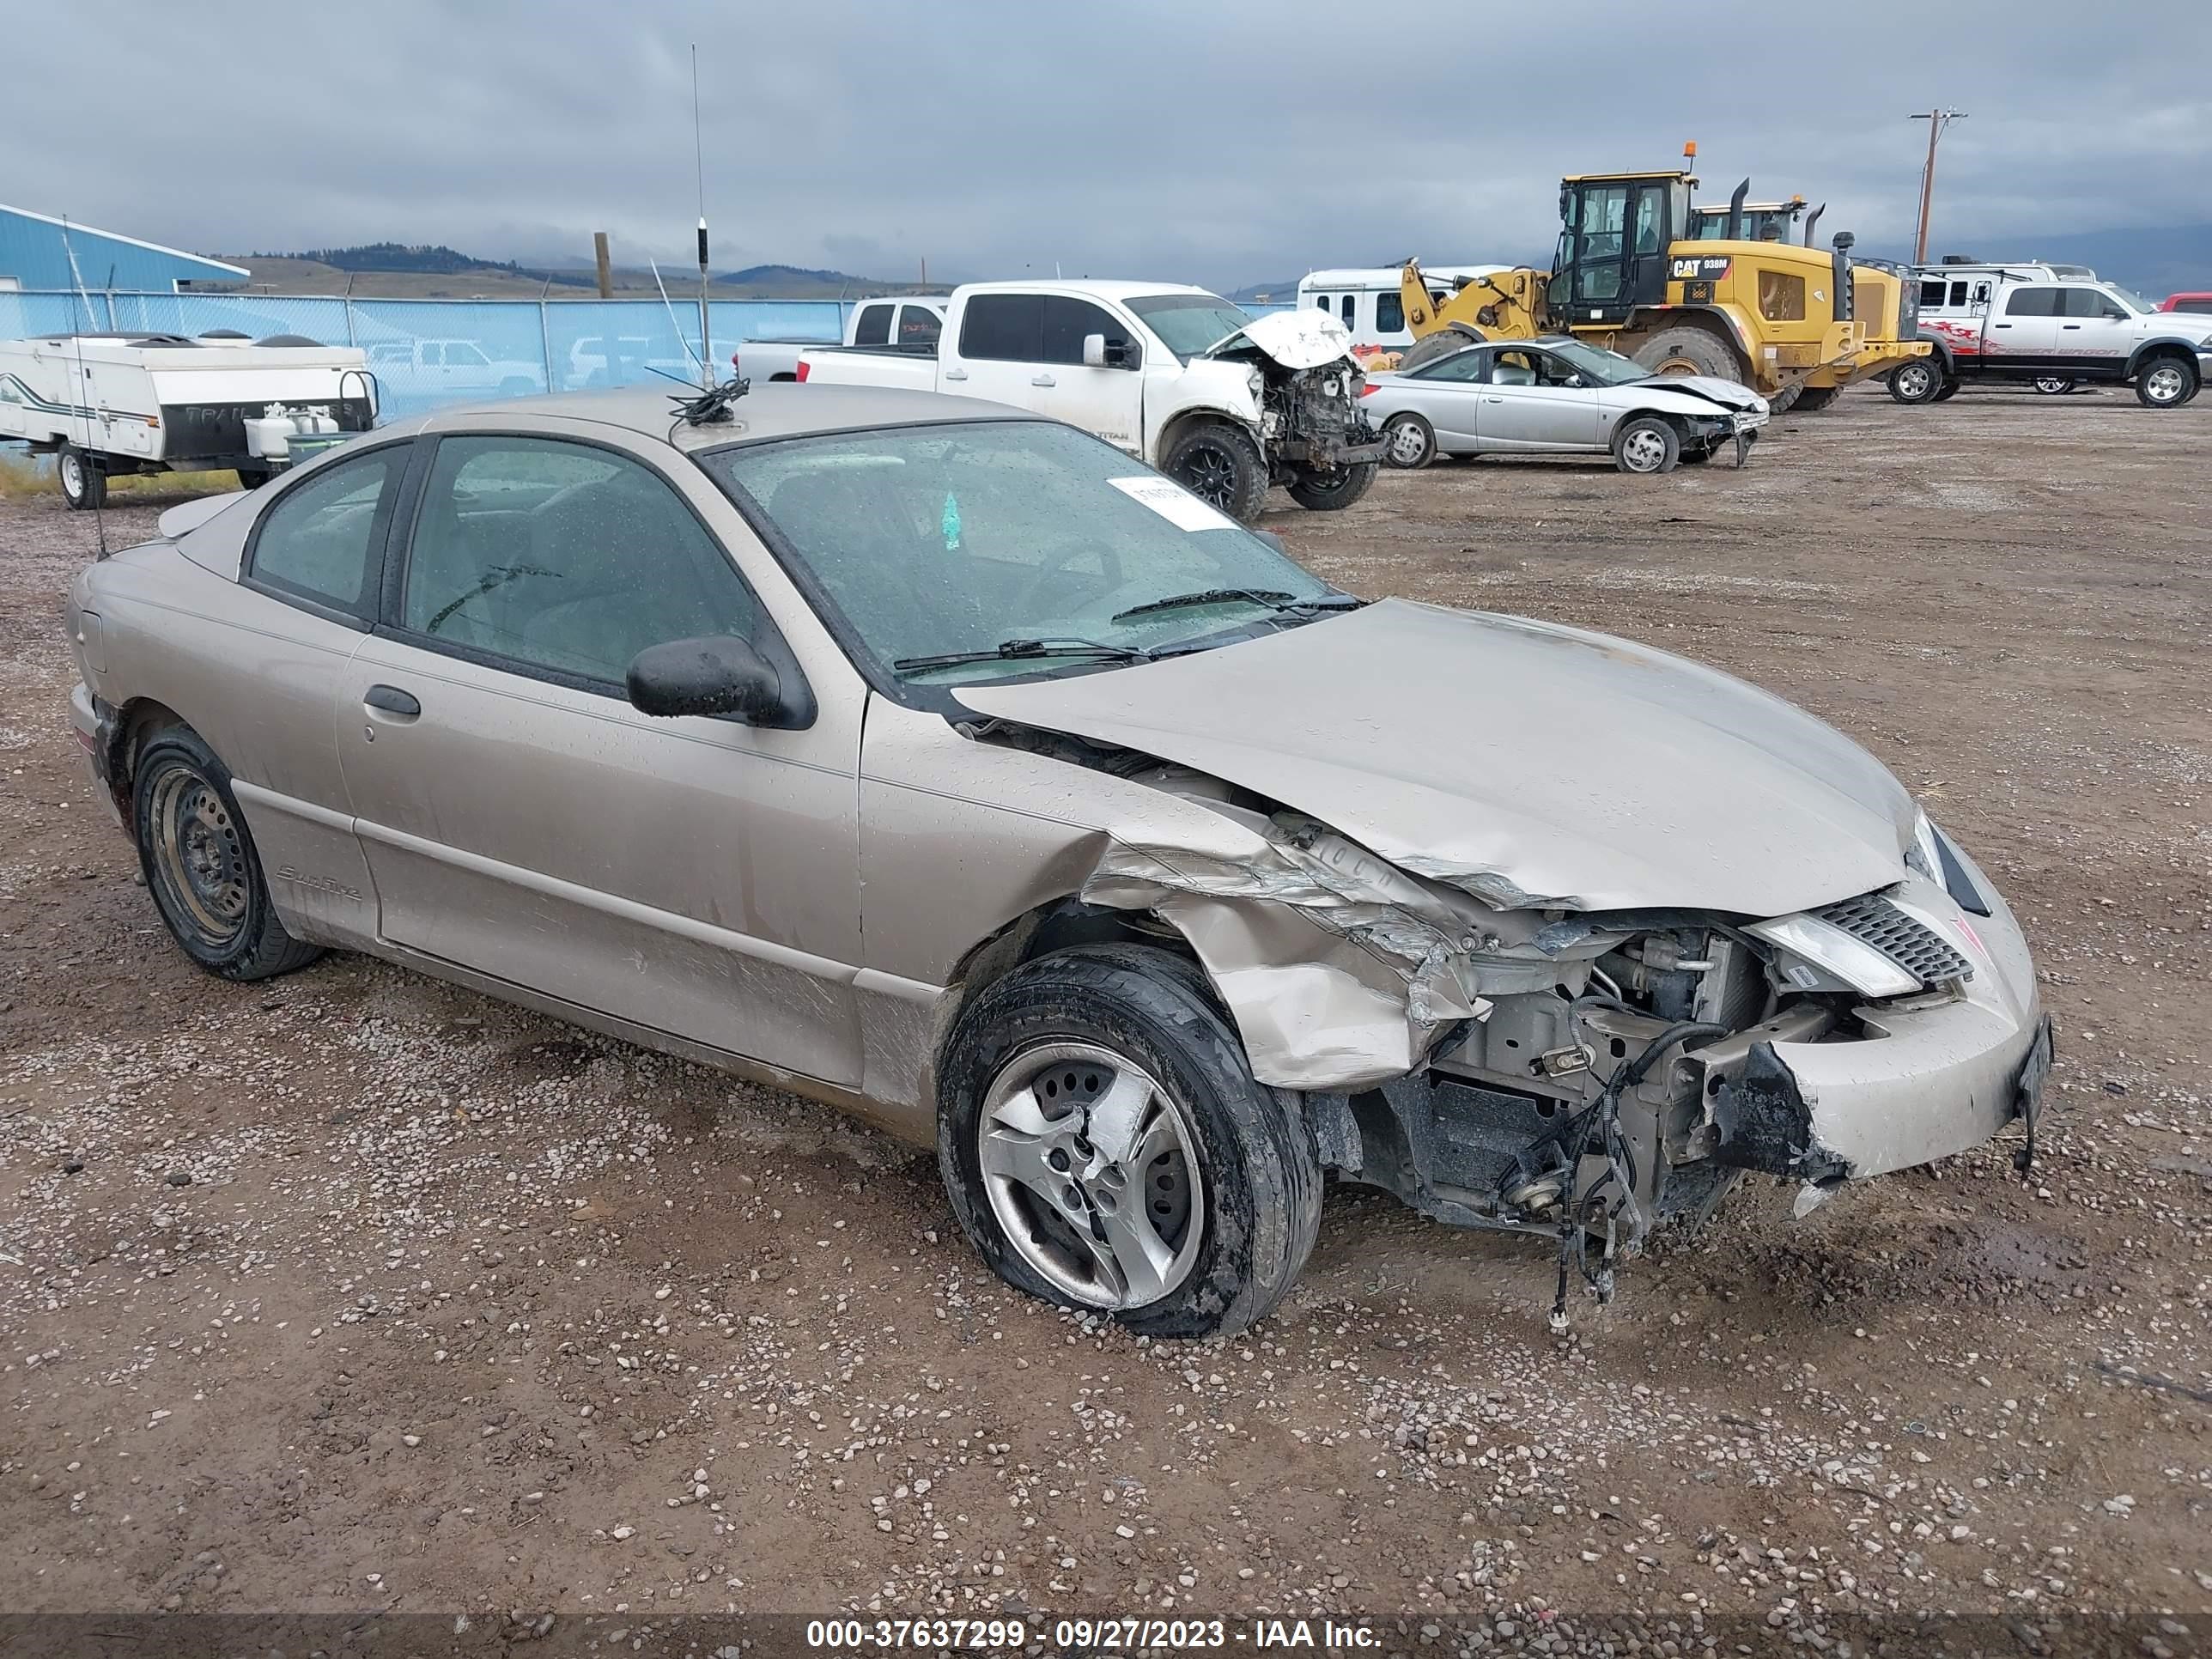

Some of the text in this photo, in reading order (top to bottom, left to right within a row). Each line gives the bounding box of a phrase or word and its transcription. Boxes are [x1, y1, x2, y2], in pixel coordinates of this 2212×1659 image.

[1673, 259, 1728, 277] CAT 938M
[1994, 347, 2120, 356] POWER WAGON
[185, 406, 252, 425] TRAIL
